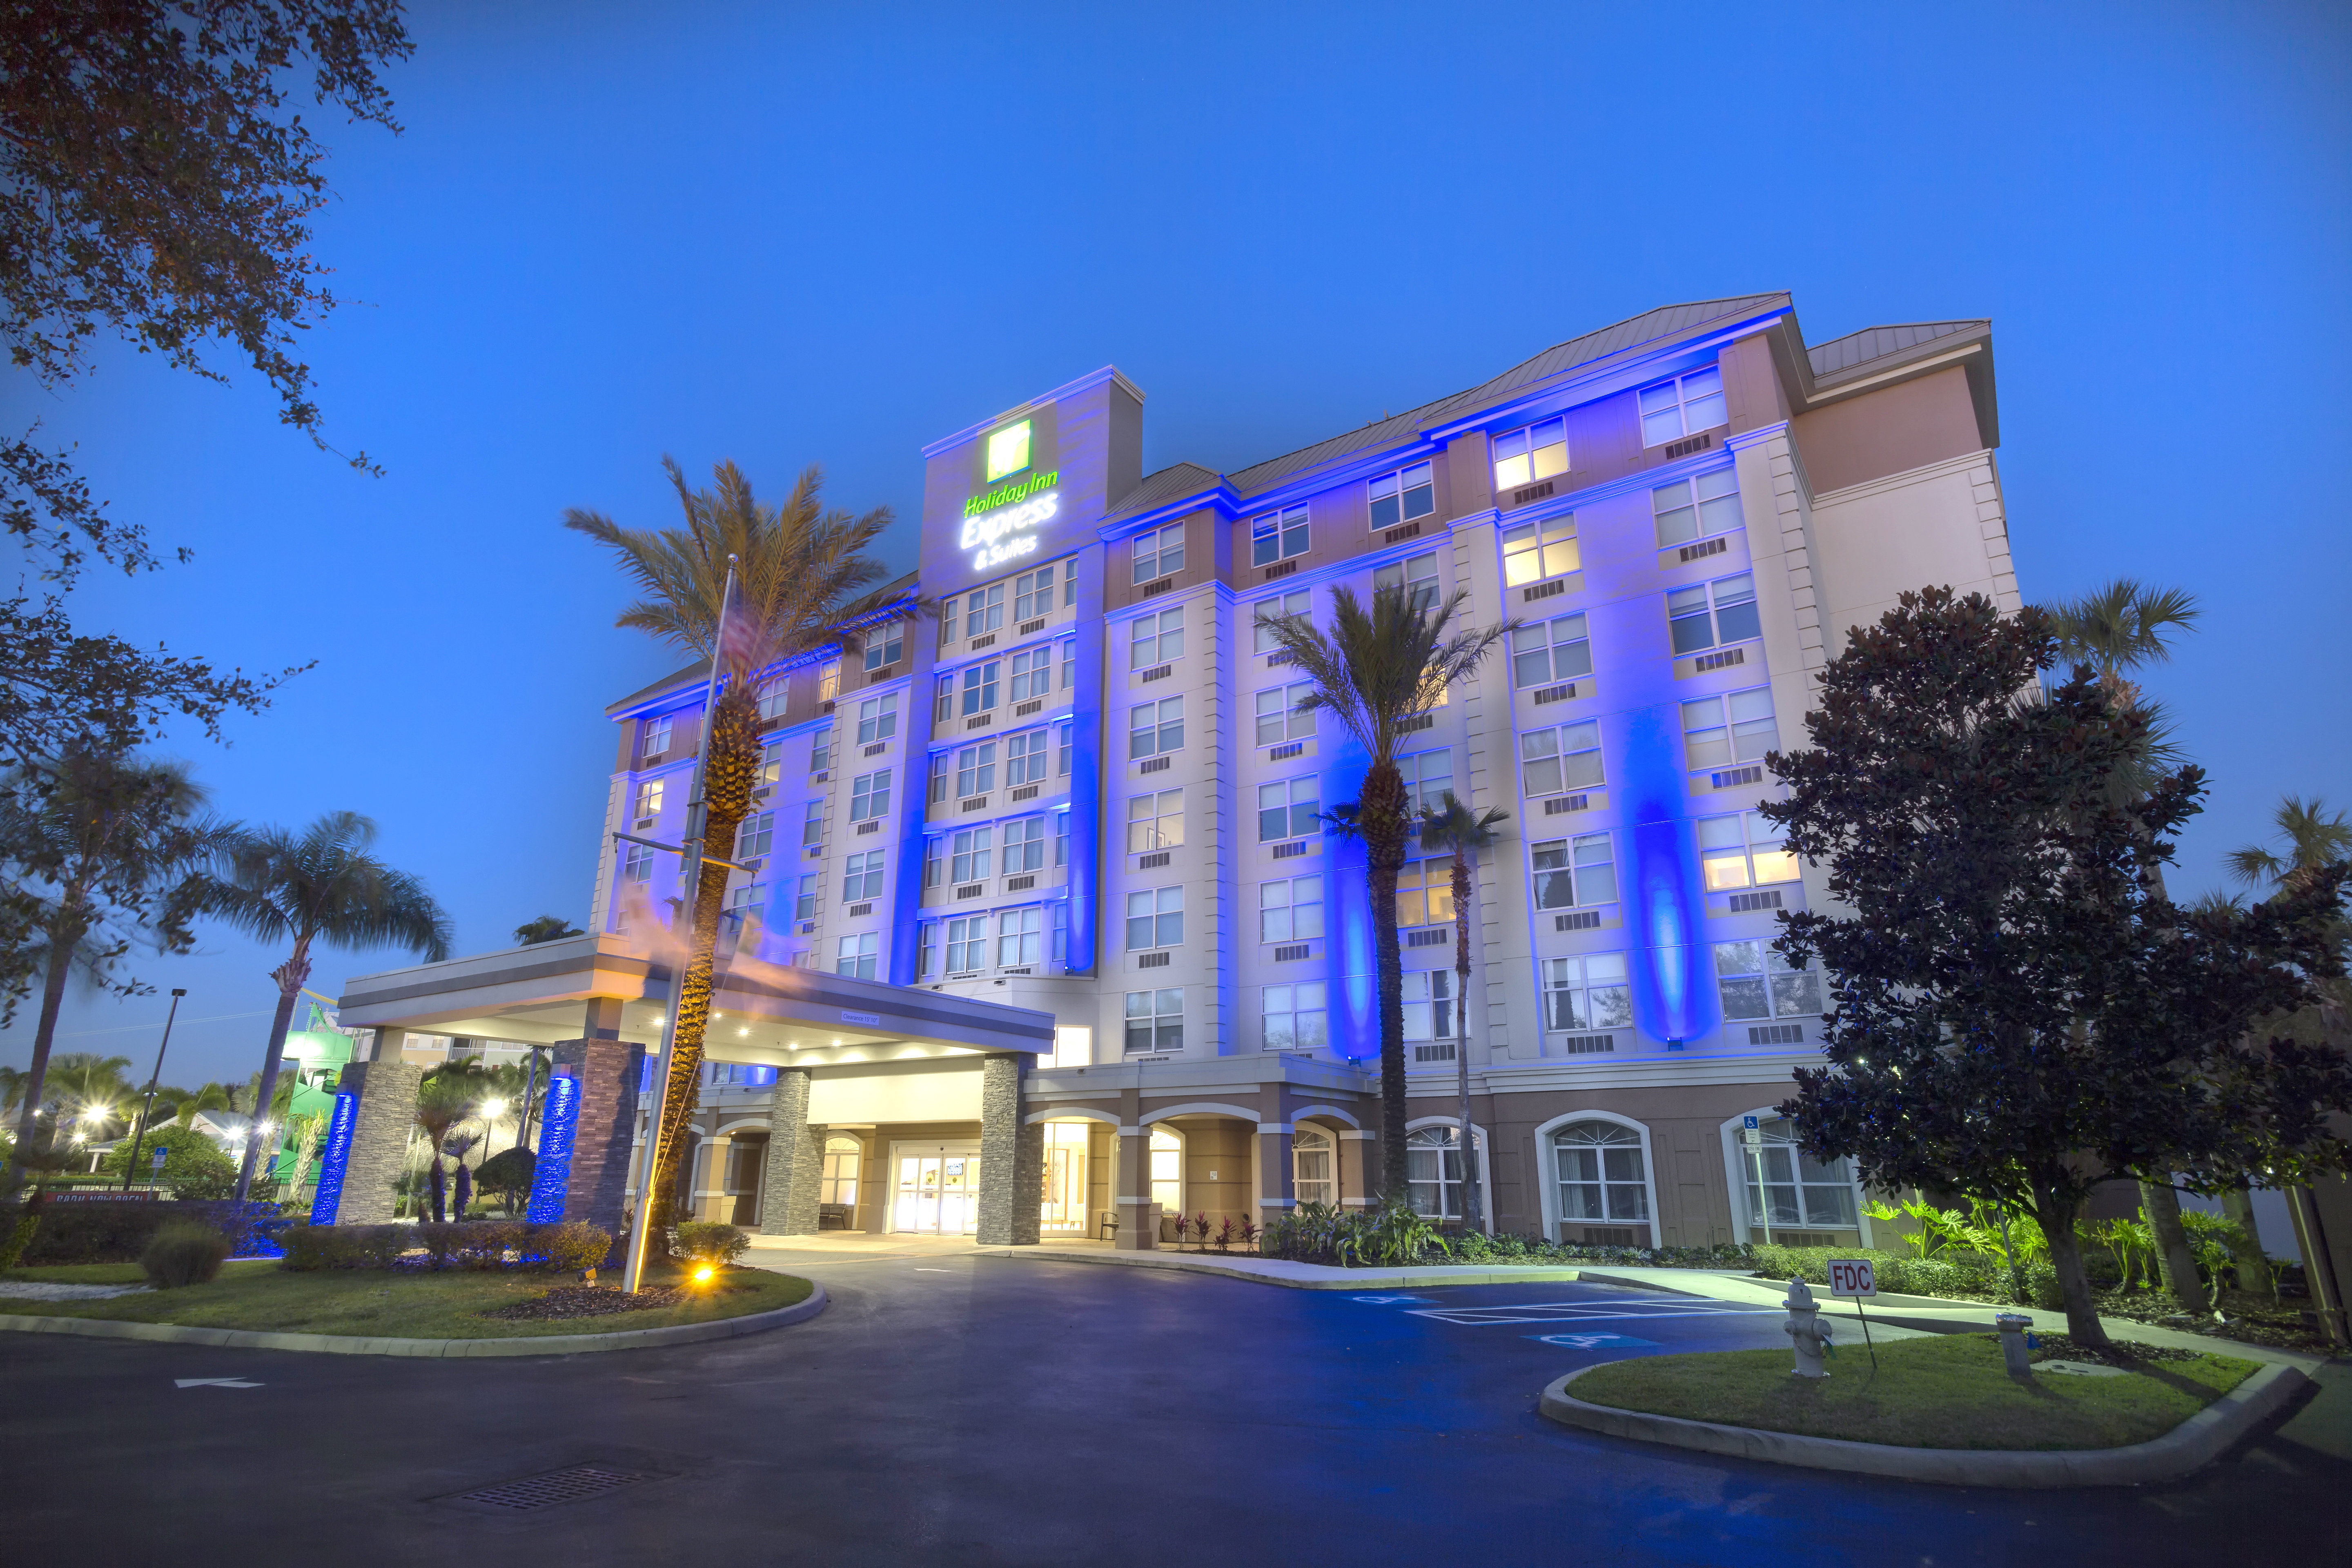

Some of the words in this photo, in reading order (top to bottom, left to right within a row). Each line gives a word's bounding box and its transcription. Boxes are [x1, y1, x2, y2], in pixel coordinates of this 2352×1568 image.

[964, 482, 1028, 519] Holiday
[1029, 471, 1058, 493] Inn
[961, 494, 1058, 549] Express
[974, 550, 987, 570] &
[989, 536, 1037, 565] Suites
[1833, 1265, 1870, 1291] FDC
